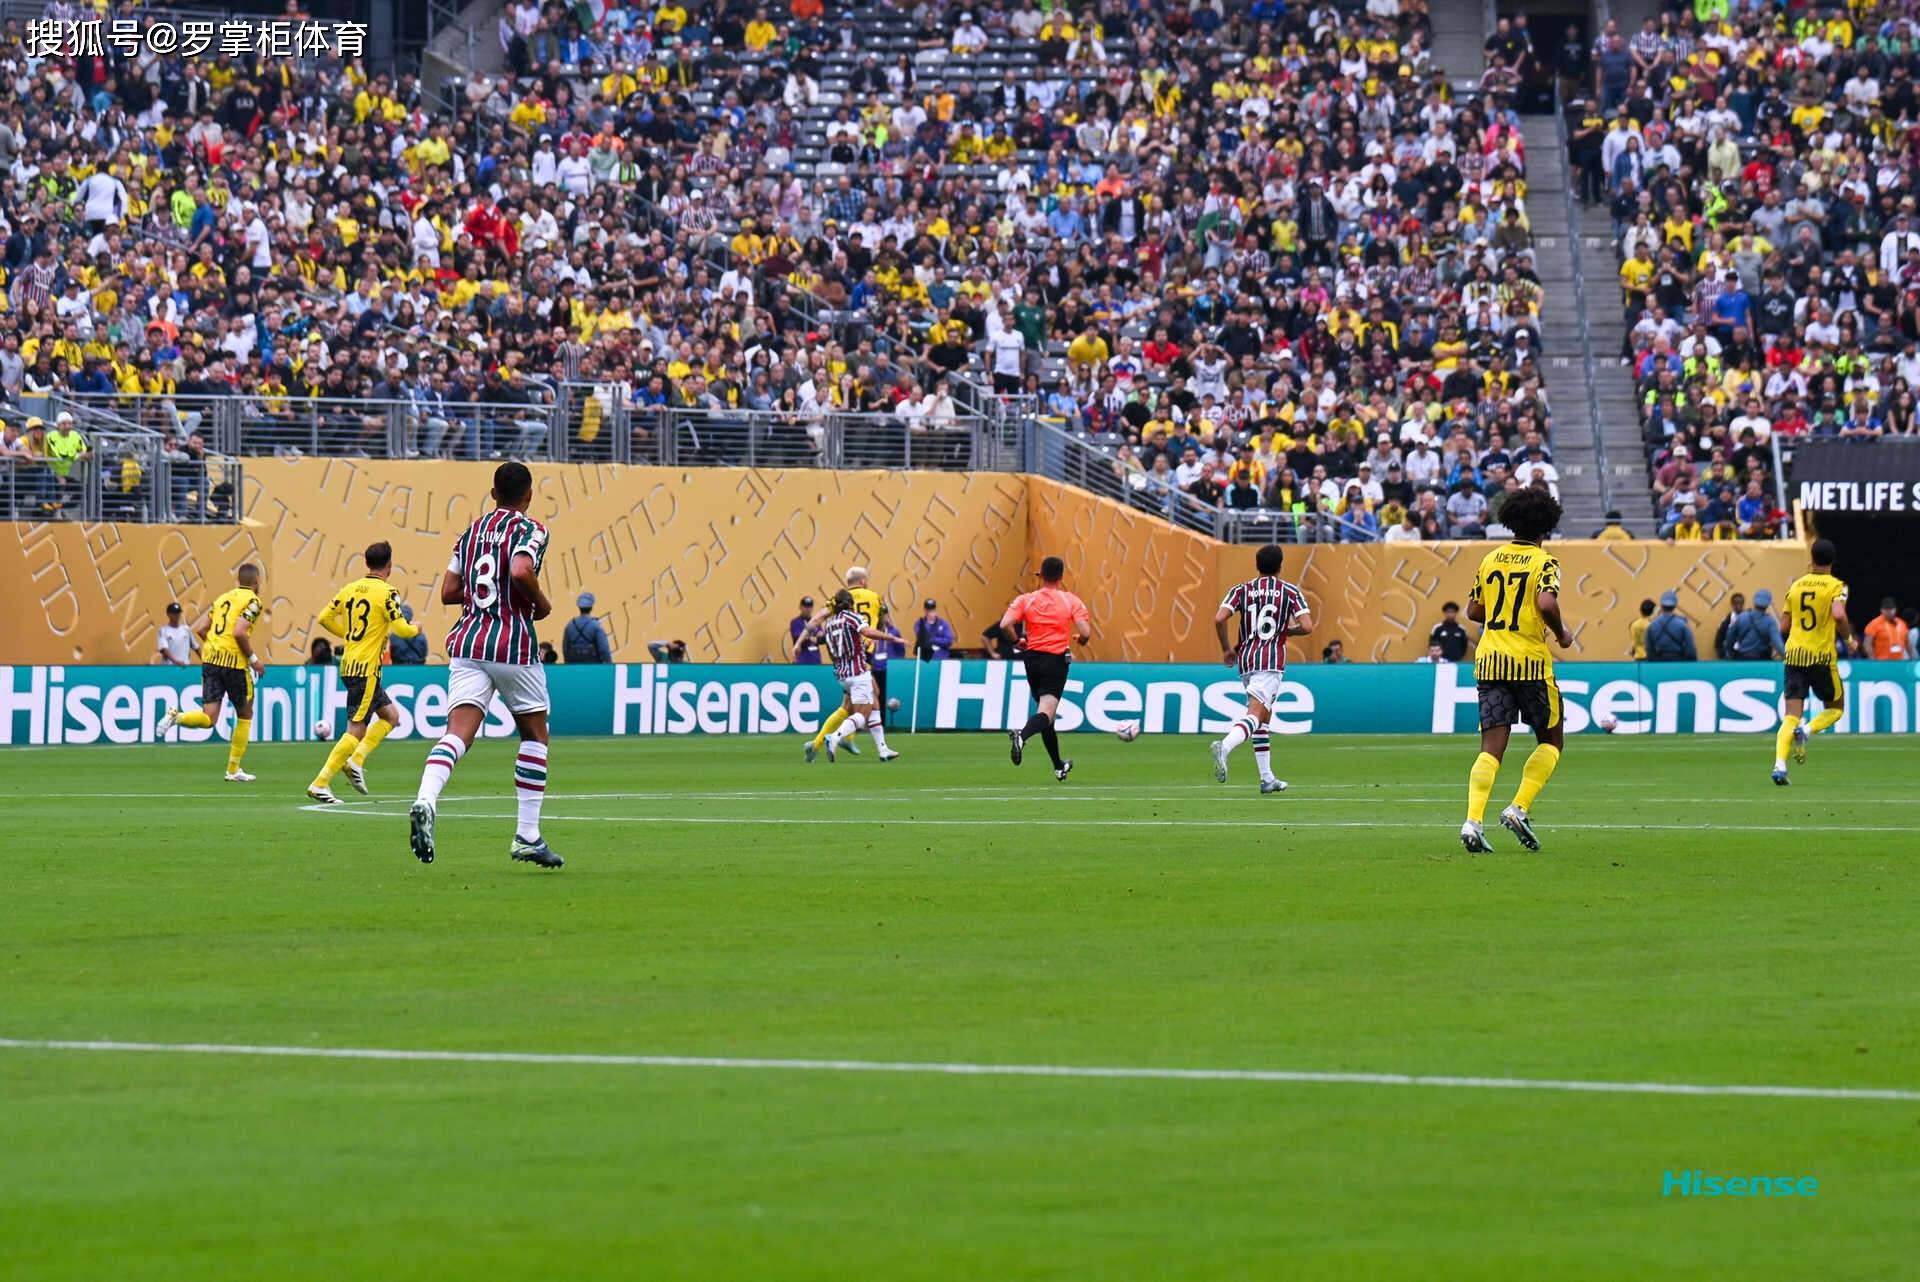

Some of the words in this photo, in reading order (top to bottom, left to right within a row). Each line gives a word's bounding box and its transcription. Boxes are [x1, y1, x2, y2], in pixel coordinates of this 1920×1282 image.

[1800, 481, 1905, 511] METLIFE
[473, 553, 498, 609] 3
[1486, 570, 1530, 632] 27
[215, 600, 231, 635] 3
[345, 597, 371, 642] 13
[1248, 603, 1278, 640] 16
[1800, 591, 1817, 632] 5
[825, 629, 843, 658] 17
[613, 664, 820, 735] Hisense
[936, 660, 1315, 734] Hisense
[1431, 662, 1832, 733] Hsens
